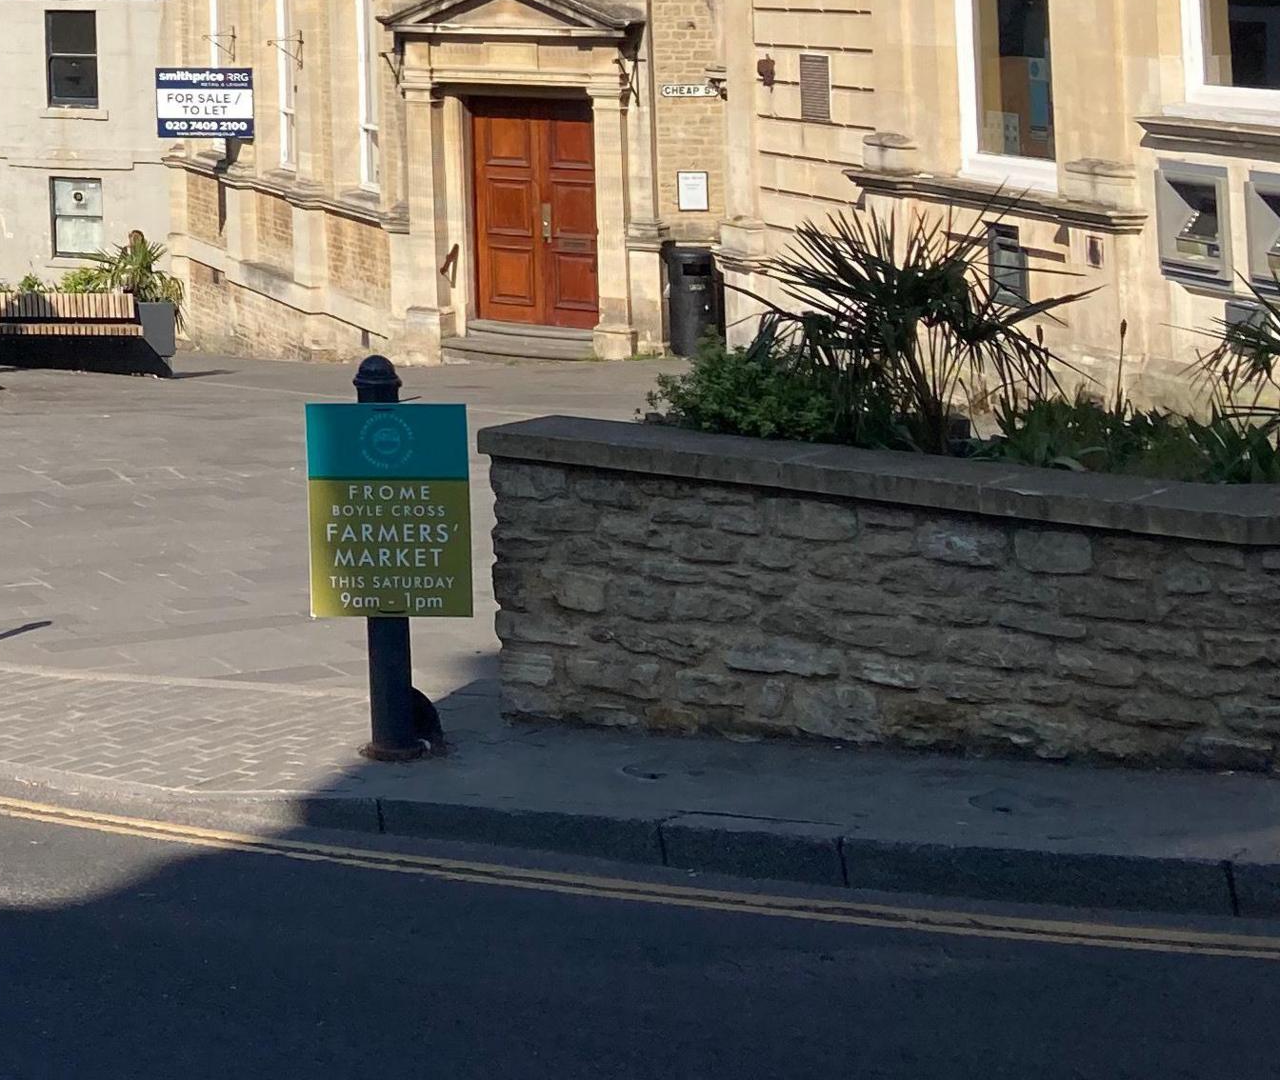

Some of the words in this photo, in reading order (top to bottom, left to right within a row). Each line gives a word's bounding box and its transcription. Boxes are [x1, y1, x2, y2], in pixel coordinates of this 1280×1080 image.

[159, 70, 225, 84] smithprice
[226, 73, 249, 82] RRG
[664, 86, 700, 95] CHEAP
[167, 93, 194, 103] FOR
[198, 93, 232, 104] SALE
[182, 105, 200, 115] TO
[204, 105, 228, 115] LET
[165, 120, 188, 130] 020
[189, 121, 218, 130] 7409
[219, 121, 248, 131] 2100
[348, 485, 430, 500] FROME
[332, 505, 383, 517] BOYLE
[391, 505, 446, 517] CROSS
[326, 523, 459, 543] FARMERS'
[334, 548, 443, 567] MARKET
[328, 575, 365, 589] THIS
[372, 575, 455, 589] SATURDAY
[340, 592, 380, 609] 9am
[404, 592, 443, 611] 1pm
